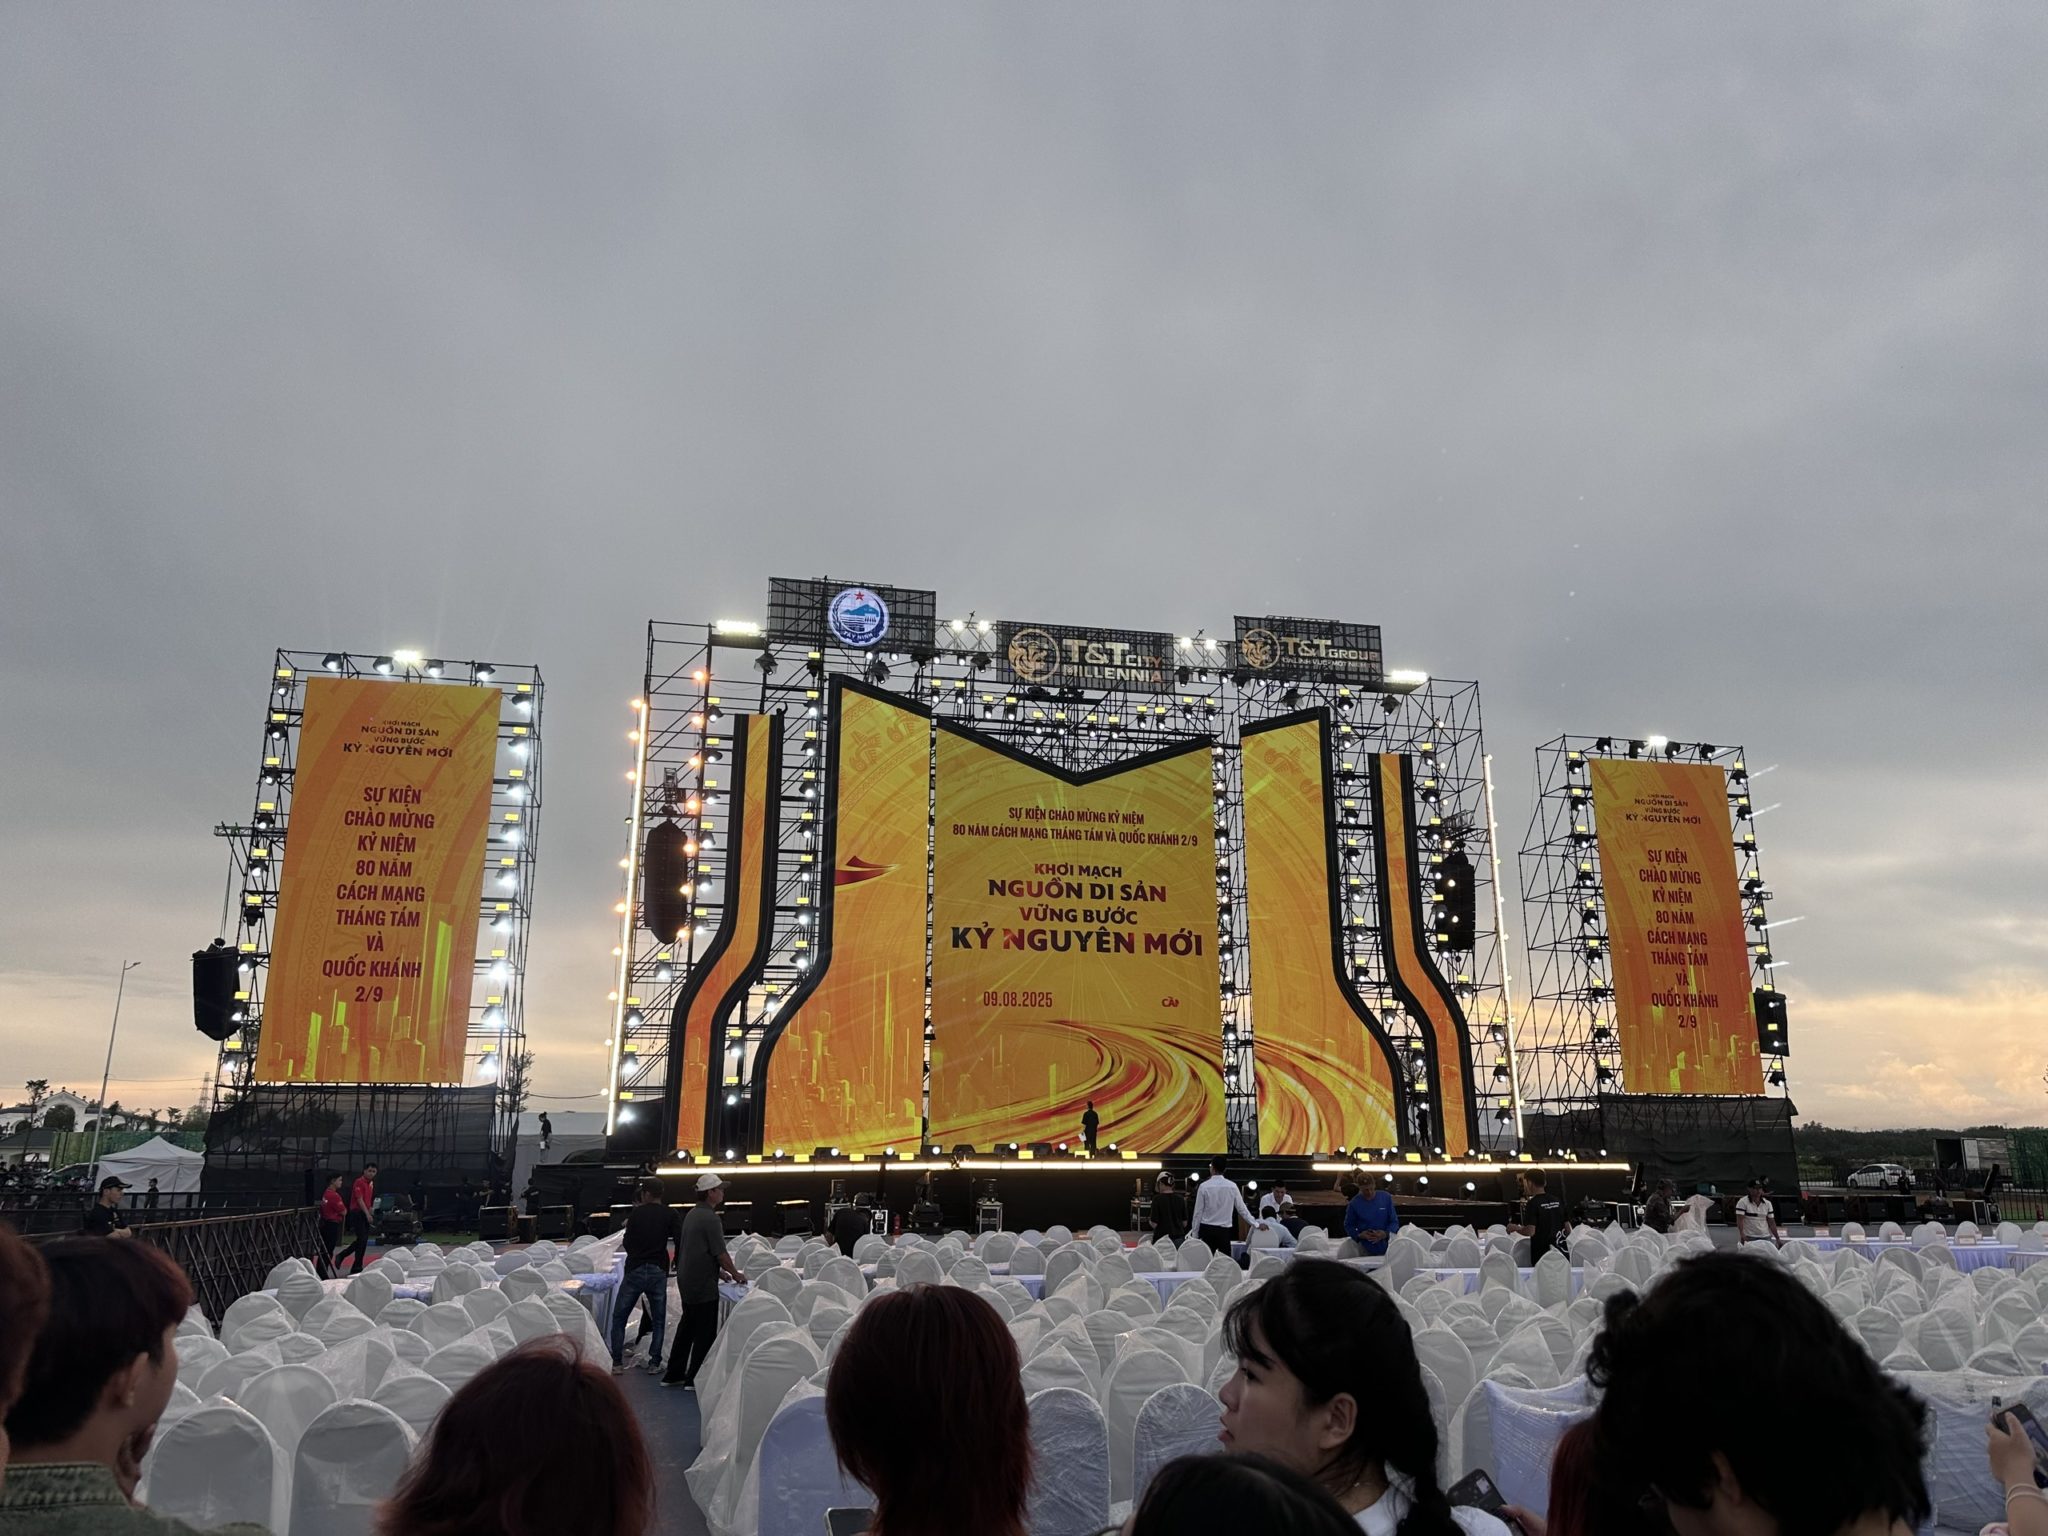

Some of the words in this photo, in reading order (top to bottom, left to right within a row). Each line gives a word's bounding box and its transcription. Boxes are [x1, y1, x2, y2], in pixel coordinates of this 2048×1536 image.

[1062, 638, 1130, 666] T&T
[1280, 636, 1331, 657] T&T
[1328, 648, 1378, 661] GROUP
[1063, 665, 1164, 683] MILLENNIA
[363, 787, 387, 806] SỰ
[388, 785, 422, 807] KIỆN
[344, 806, 386, 827] CHÀO
[389, 808, 435, 829] MỪNG
[1009, 807, 1023, 821] SỰ
[1025, 805, 1046, 822] KIỆN
[1048, 806, 1074, 822] CHÀO
[1077, 808, 1106, 823] MỪNG
[1108, 809, 1120, 824] KỶ
[1122, 810, 1145, 827] NIỆM
[357, 831, 377, 851] KỶ
[380, 832, 416, 856] NIỆM
[952, 824, 966, 835] 80
[967, 823, 989, 837] NĂM
[991, 823, 1018, 838] CÁCH
[1020, 827, 1048, 841] MẠNG
[1050, 826, 1082, 841] THÁNG
[1084, 827, 1103, 841] TÁM
[1105, 828, 1117, 842] VÀ
[1119, 828, 1146, 844] QUỐC
[1147, 830, 1179, 846] KHÁNH
[1181, 834, 1198, 847] 2/9
[1647, 849, 1662, 866] SỰ
[1665, 847, 1688, 866] KIỆN
[356, 860, 375, 876] 80
[379, 858, 412, 877] NĂM
[1034, 862, 1074, 876] KHƠI
[1078, 865, 1122, 879] MẠCH
[1639, 865, 1667, 883] CHÀO
[1669, 867, 1702, 884] MỪNG
[336, 880, 378, 901] CÁCH
[381, 885, 425, 905] MẠNG
[988, 877, 1082, 899] NGUỒN
[1090, 883, 1114, 900] DI
[1120, 880, 1166, 902] SẢN
[1652, 886, 1665, 903] KỶ
[1667, 887, 1693, 907] NIỆM
[336, 905, 386, 926] THÁNG
[390, 906, 421, 927] TÁM
[1019, 903, 1078, 923] VỮNG
[1083, 906, 1138, 925] BƯỚC
[1656, 910, 1670, 924] 80
[1671, 908, 1695, 925] NĂM
[366, 931, 384, 951] VÀ
[951, 921, 995, 950] KỶ
[1002, 925, 1135, 954] NGUYÊN
[1143, 928, 1203, 956] MỚI
[1647, 927, 1676, 945] CÁCH
[1677, 931, 1708, 948] MẠNG
[322, 953, 366, 978] QUỐC
[369, 957, 422, 978] KHÁNH
[1651, 948, 1686, 965] THÁNG
[1687, 949, 1709, 966] TÁM
[1675, 969, 1690, 986] VÀ
[354, 986, 383, 1003] 2/9
[983, 991, 1053, 1008] 09.08.2025
[1651, 987, 1681, 1008] QUỐC
[1683, 990, 1719, 1008] KHÁNH
[1678, 1014, 1697, 1029] 2/9
